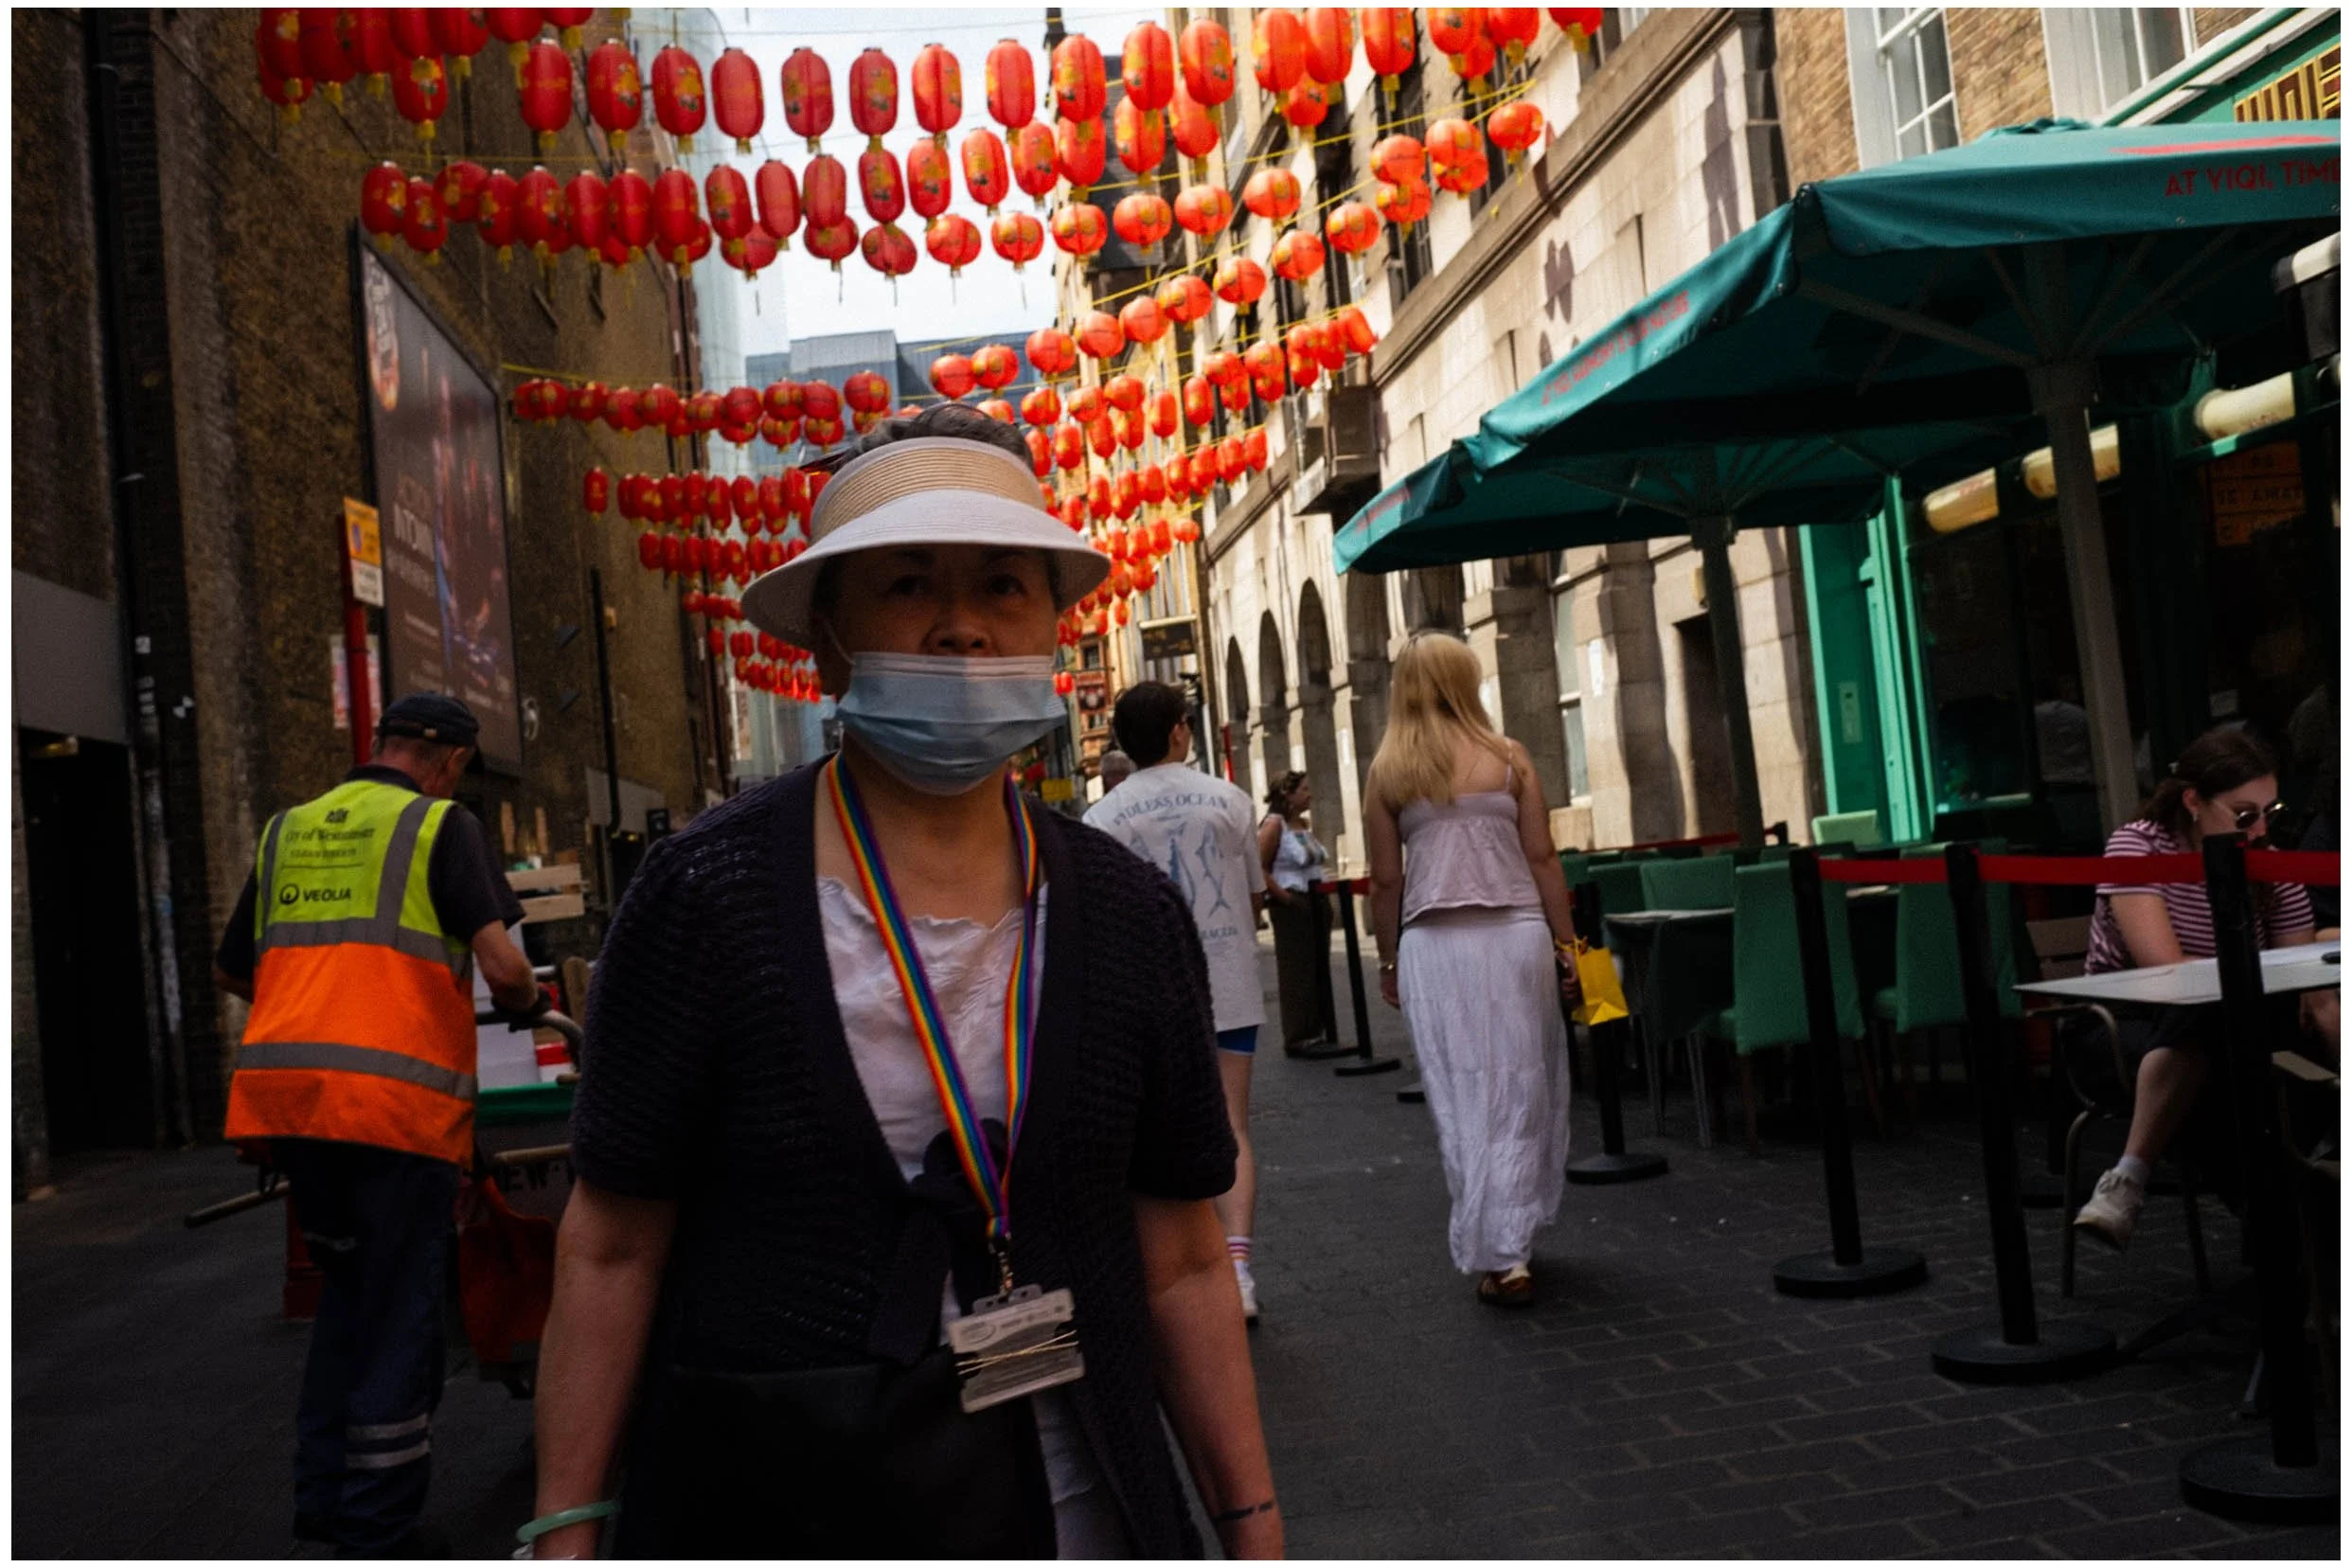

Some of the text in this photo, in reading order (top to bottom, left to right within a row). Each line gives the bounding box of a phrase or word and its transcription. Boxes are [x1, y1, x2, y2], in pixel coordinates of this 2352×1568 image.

[2165, 169, 2198, 197] AT
[1175, 792, 1228, 810] OCEAN
[303, 887, 351, 902] VEOLIA
